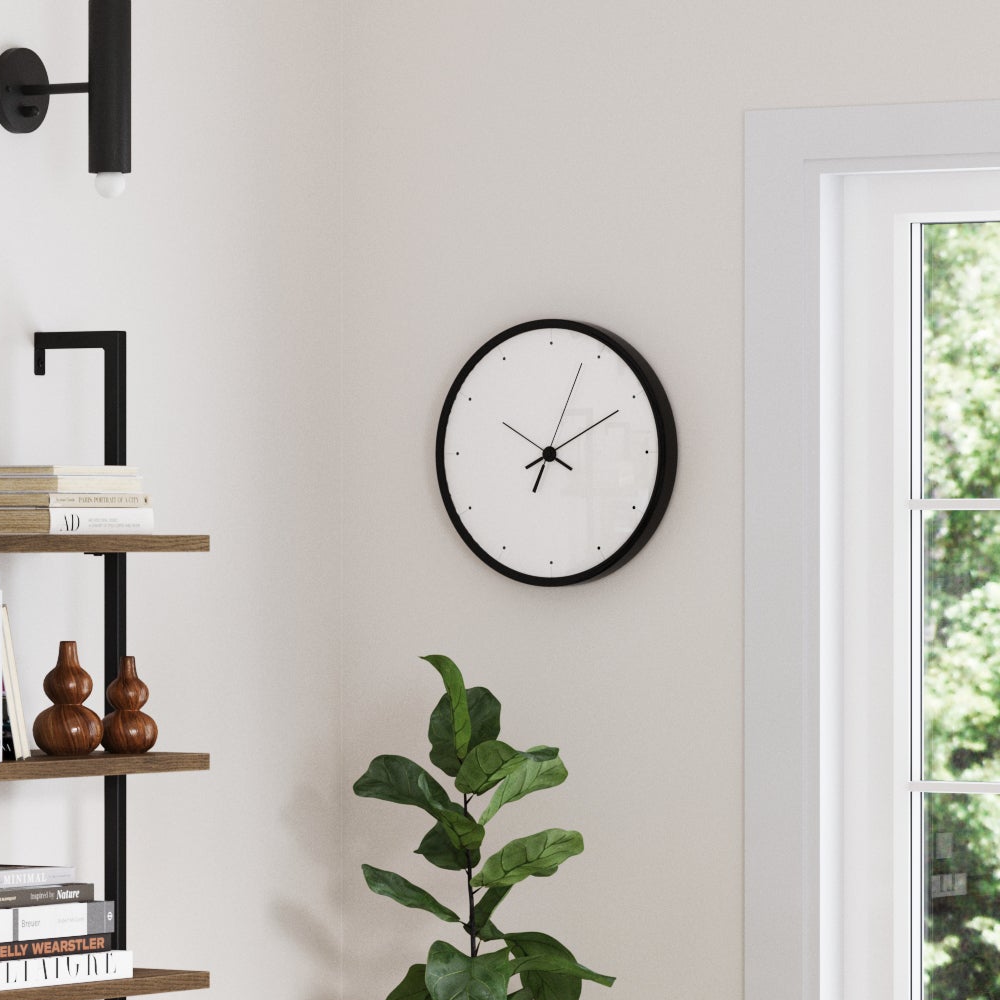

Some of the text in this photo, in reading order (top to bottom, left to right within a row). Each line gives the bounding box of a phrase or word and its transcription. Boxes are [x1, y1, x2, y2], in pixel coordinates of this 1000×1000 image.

[60, 513, 80, 532] AD
[3, 872, 48, 885] MINIMAL
[30, 890, 48, 902] Inspired
[56, 889, 80, 900] Nature
[21, 918, 41, 928] Breuer
[31, 937, 105, 955] WEARSTLER
